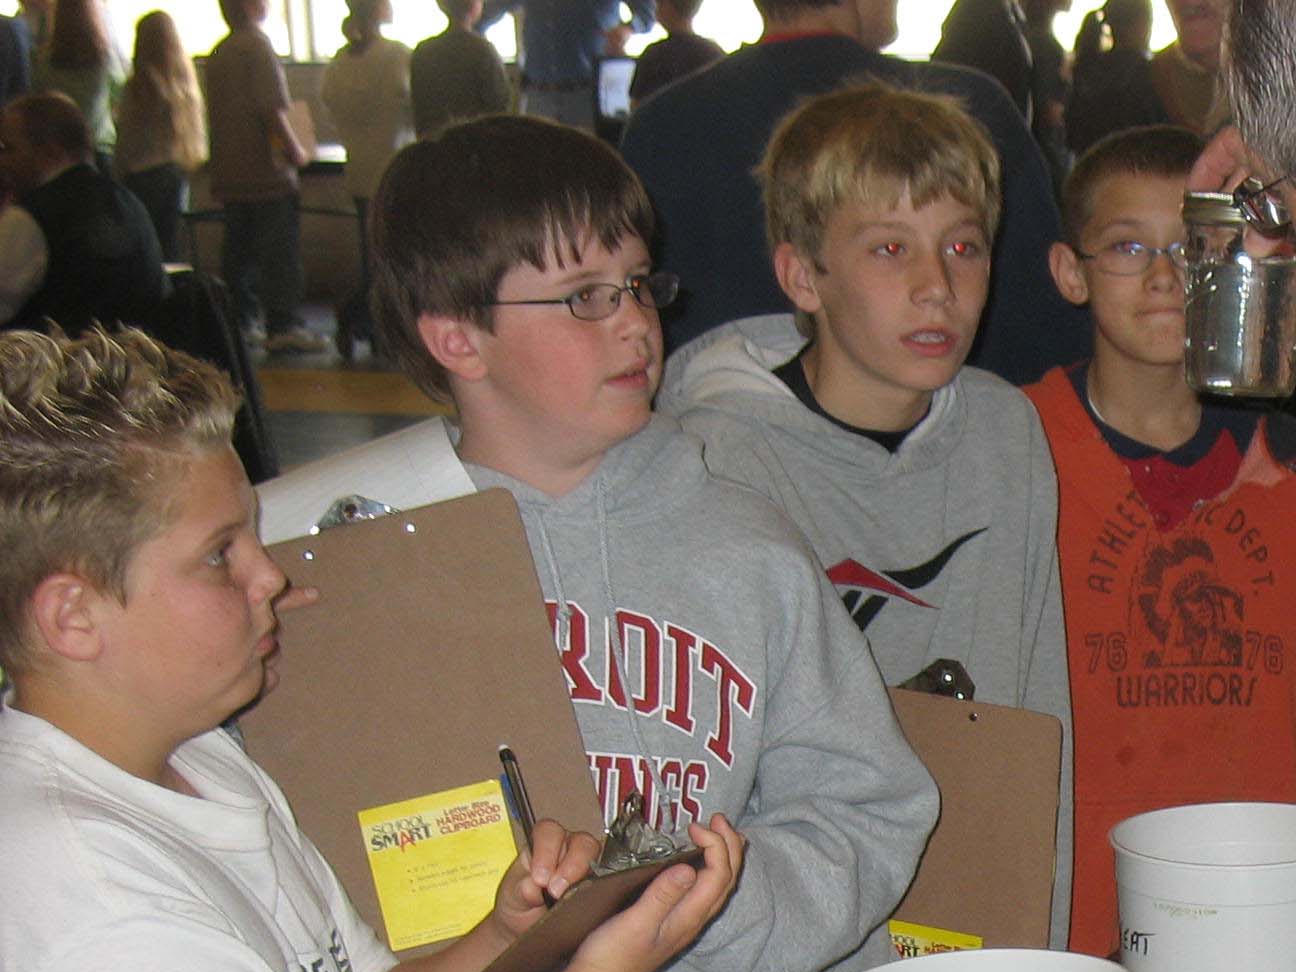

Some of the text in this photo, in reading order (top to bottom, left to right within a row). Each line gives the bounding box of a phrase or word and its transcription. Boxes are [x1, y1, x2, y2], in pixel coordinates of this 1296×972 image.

[1084, 631, 1128, 674] 76
[1246, 630, 1284, 675] 76
[371, 824, 433, 852] SMART
[440, 813, 502, 836] CLIPBOARD
